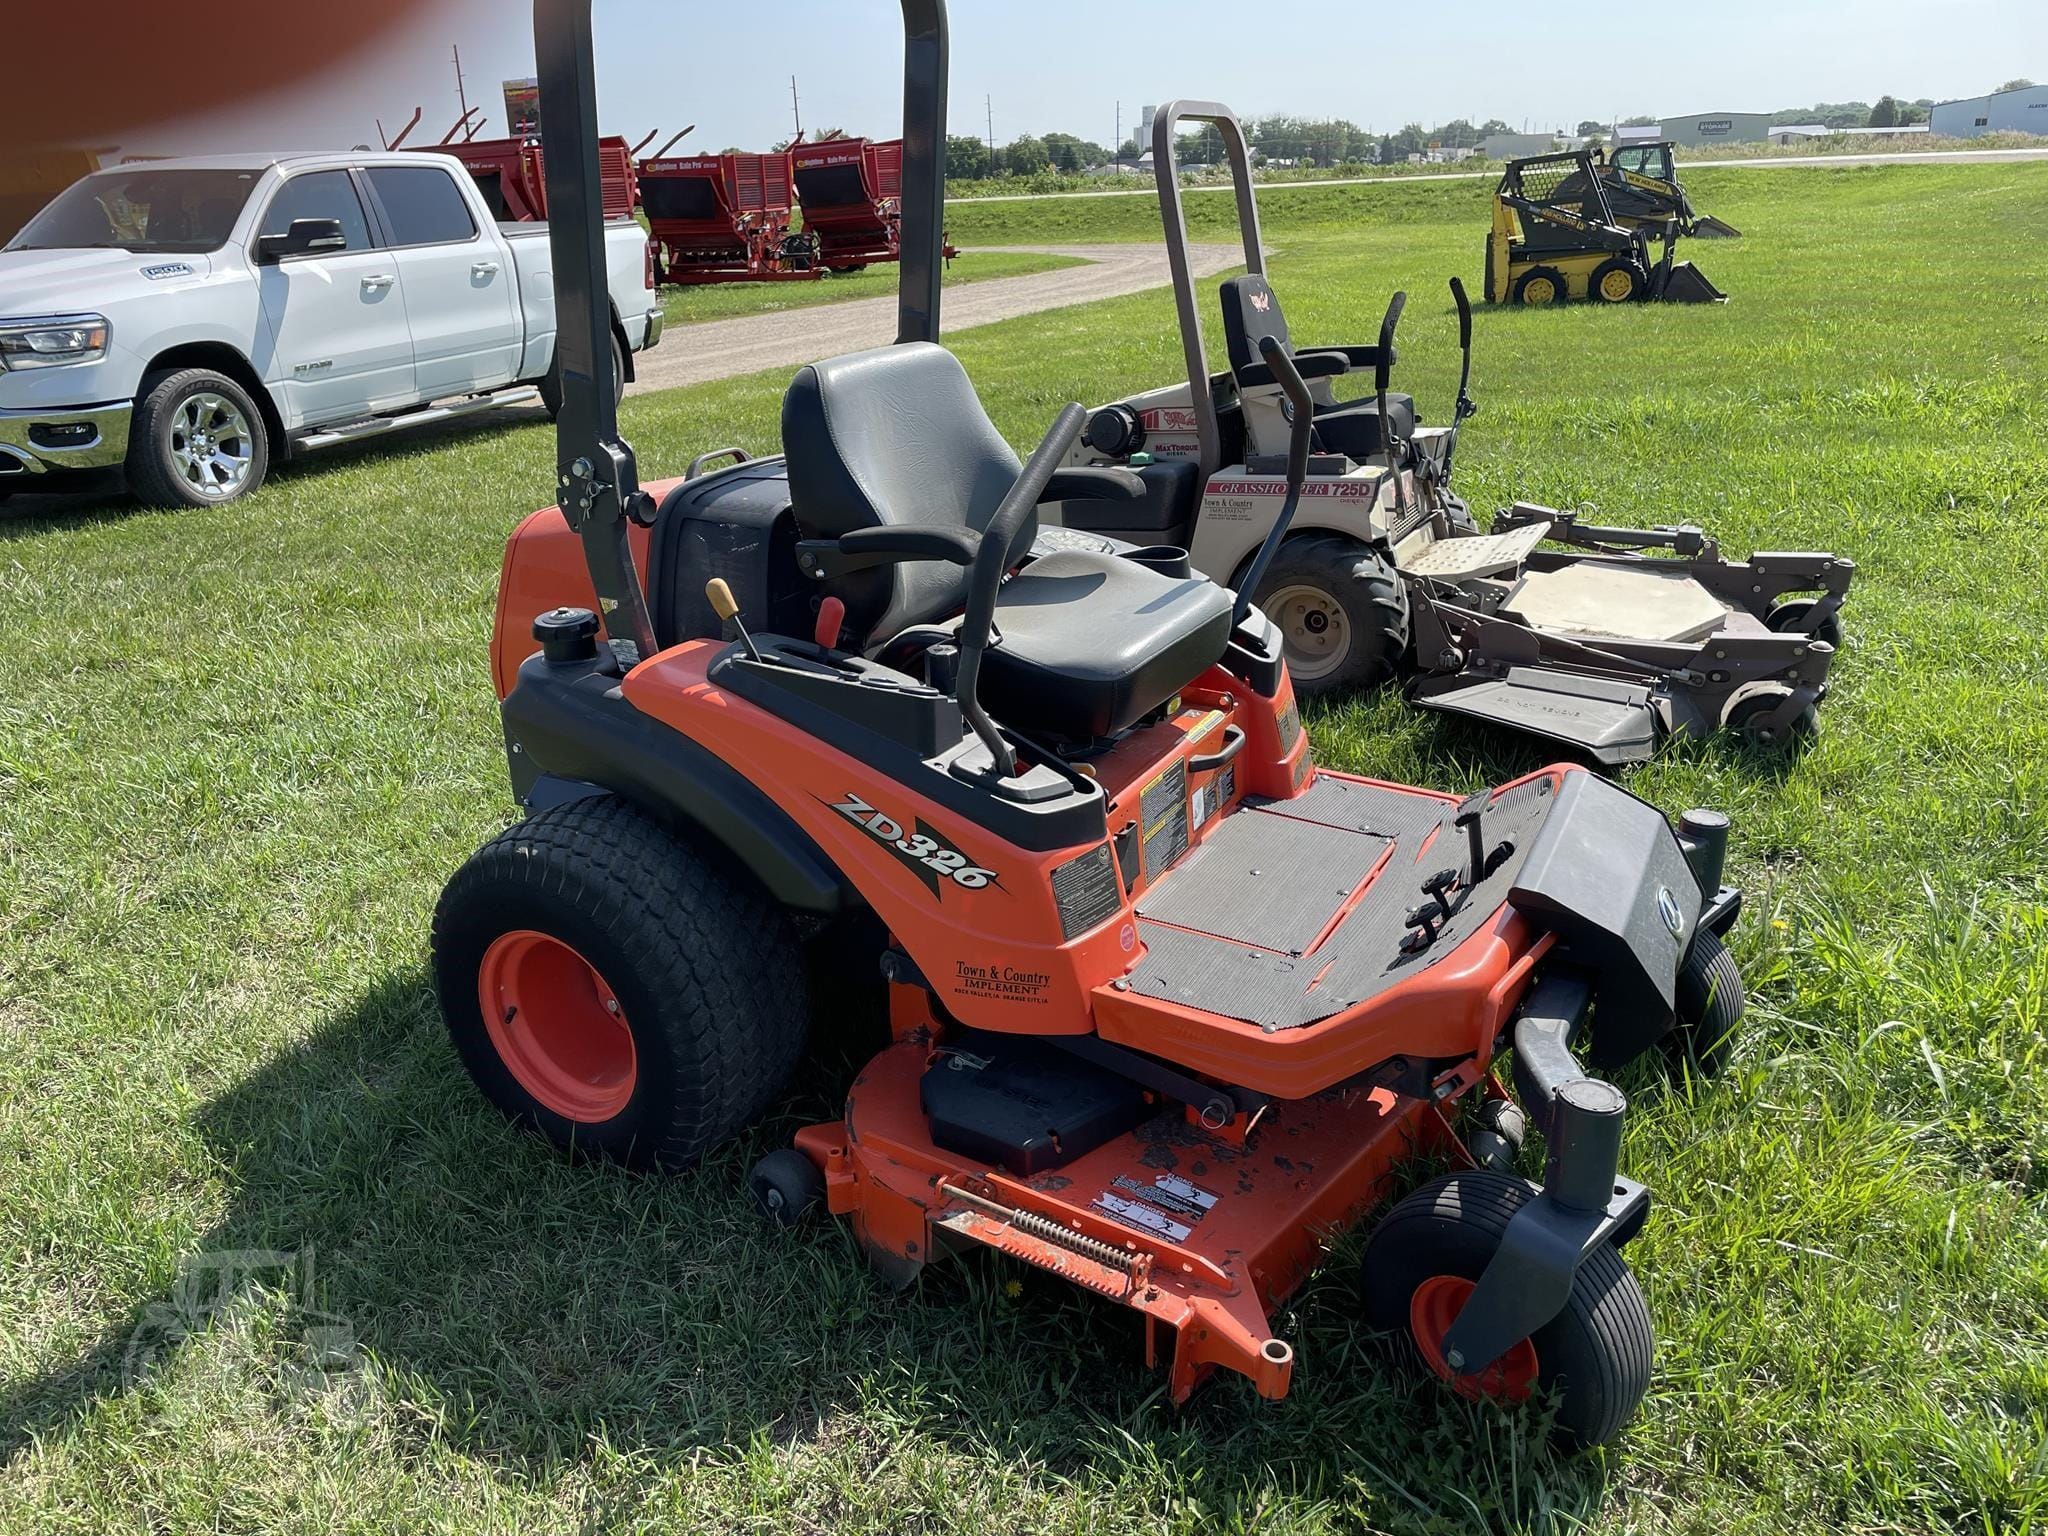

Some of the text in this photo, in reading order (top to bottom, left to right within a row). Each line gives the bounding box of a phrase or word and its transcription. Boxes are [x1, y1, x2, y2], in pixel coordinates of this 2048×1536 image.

[293, 359, 333, 372] RAM
[1331, 483, 1370, 496] 725D
[1228, 498, 1253, 510] Country
[956, 960, 1051, 988] Town & Country
[964, 978, 1040, 995] IMPLEMENT
[1136, 1200, 1167, 1217] DANGER
